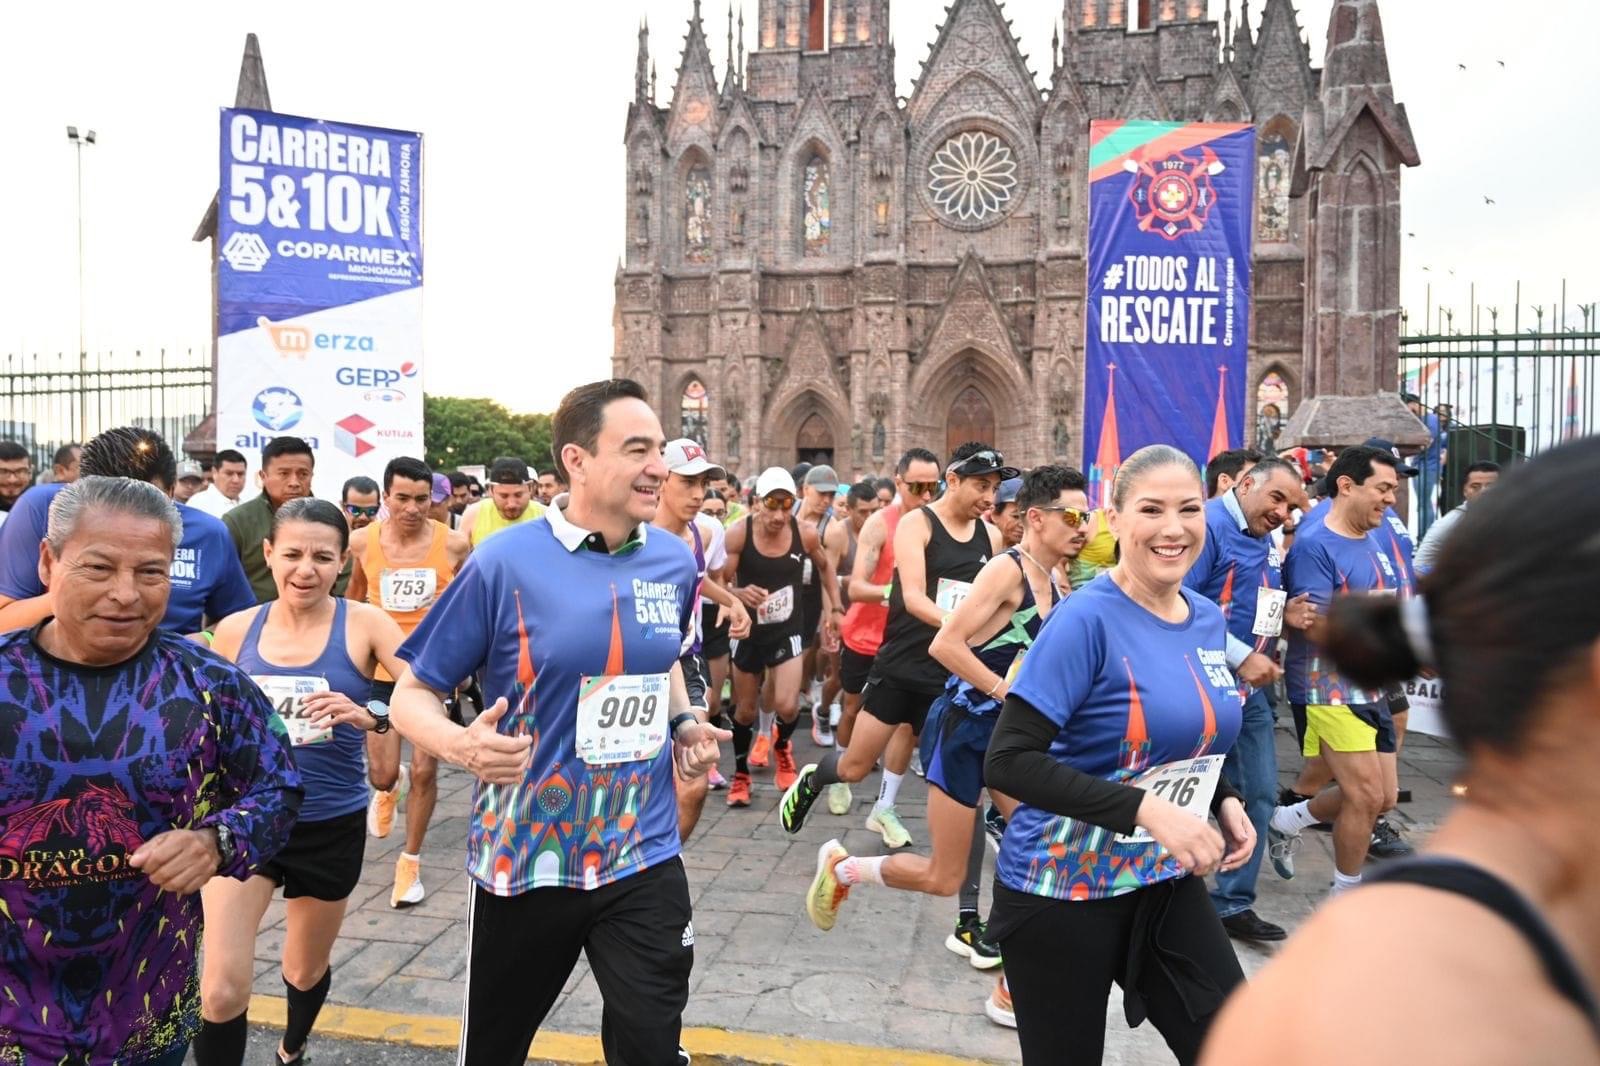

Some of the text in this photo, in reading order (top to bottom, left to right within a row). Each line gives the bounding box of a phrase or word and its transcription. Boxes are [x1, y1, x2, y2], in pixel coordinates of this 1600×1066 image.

[230, 114, 391, 178] CARRERA
[400, 144, 411, 194] ZAMORA
[1162, 161, 1185, 170] 1977
[230, 163, 394, 238] 5&10K
[277, 240, 411, 266] COPARMEX
[1102, 255, 1219, 292] #TODOS AL
[1226, 257, 1234, 287] causa
[1226, 288, 1234, 307] con
[1100, 295, 1220, 345] RESCATE
[336, 367, 401, 387] GEPP
[377, 430, 414, 438] KUTIJA
[392, 580, 426, 596] 753
[766, 596, 788, 614] 654
[597, 695, 658, 729] 909
[1152, 776, 1200, 807] 716
[25, 848, 89, 862] TEAM
